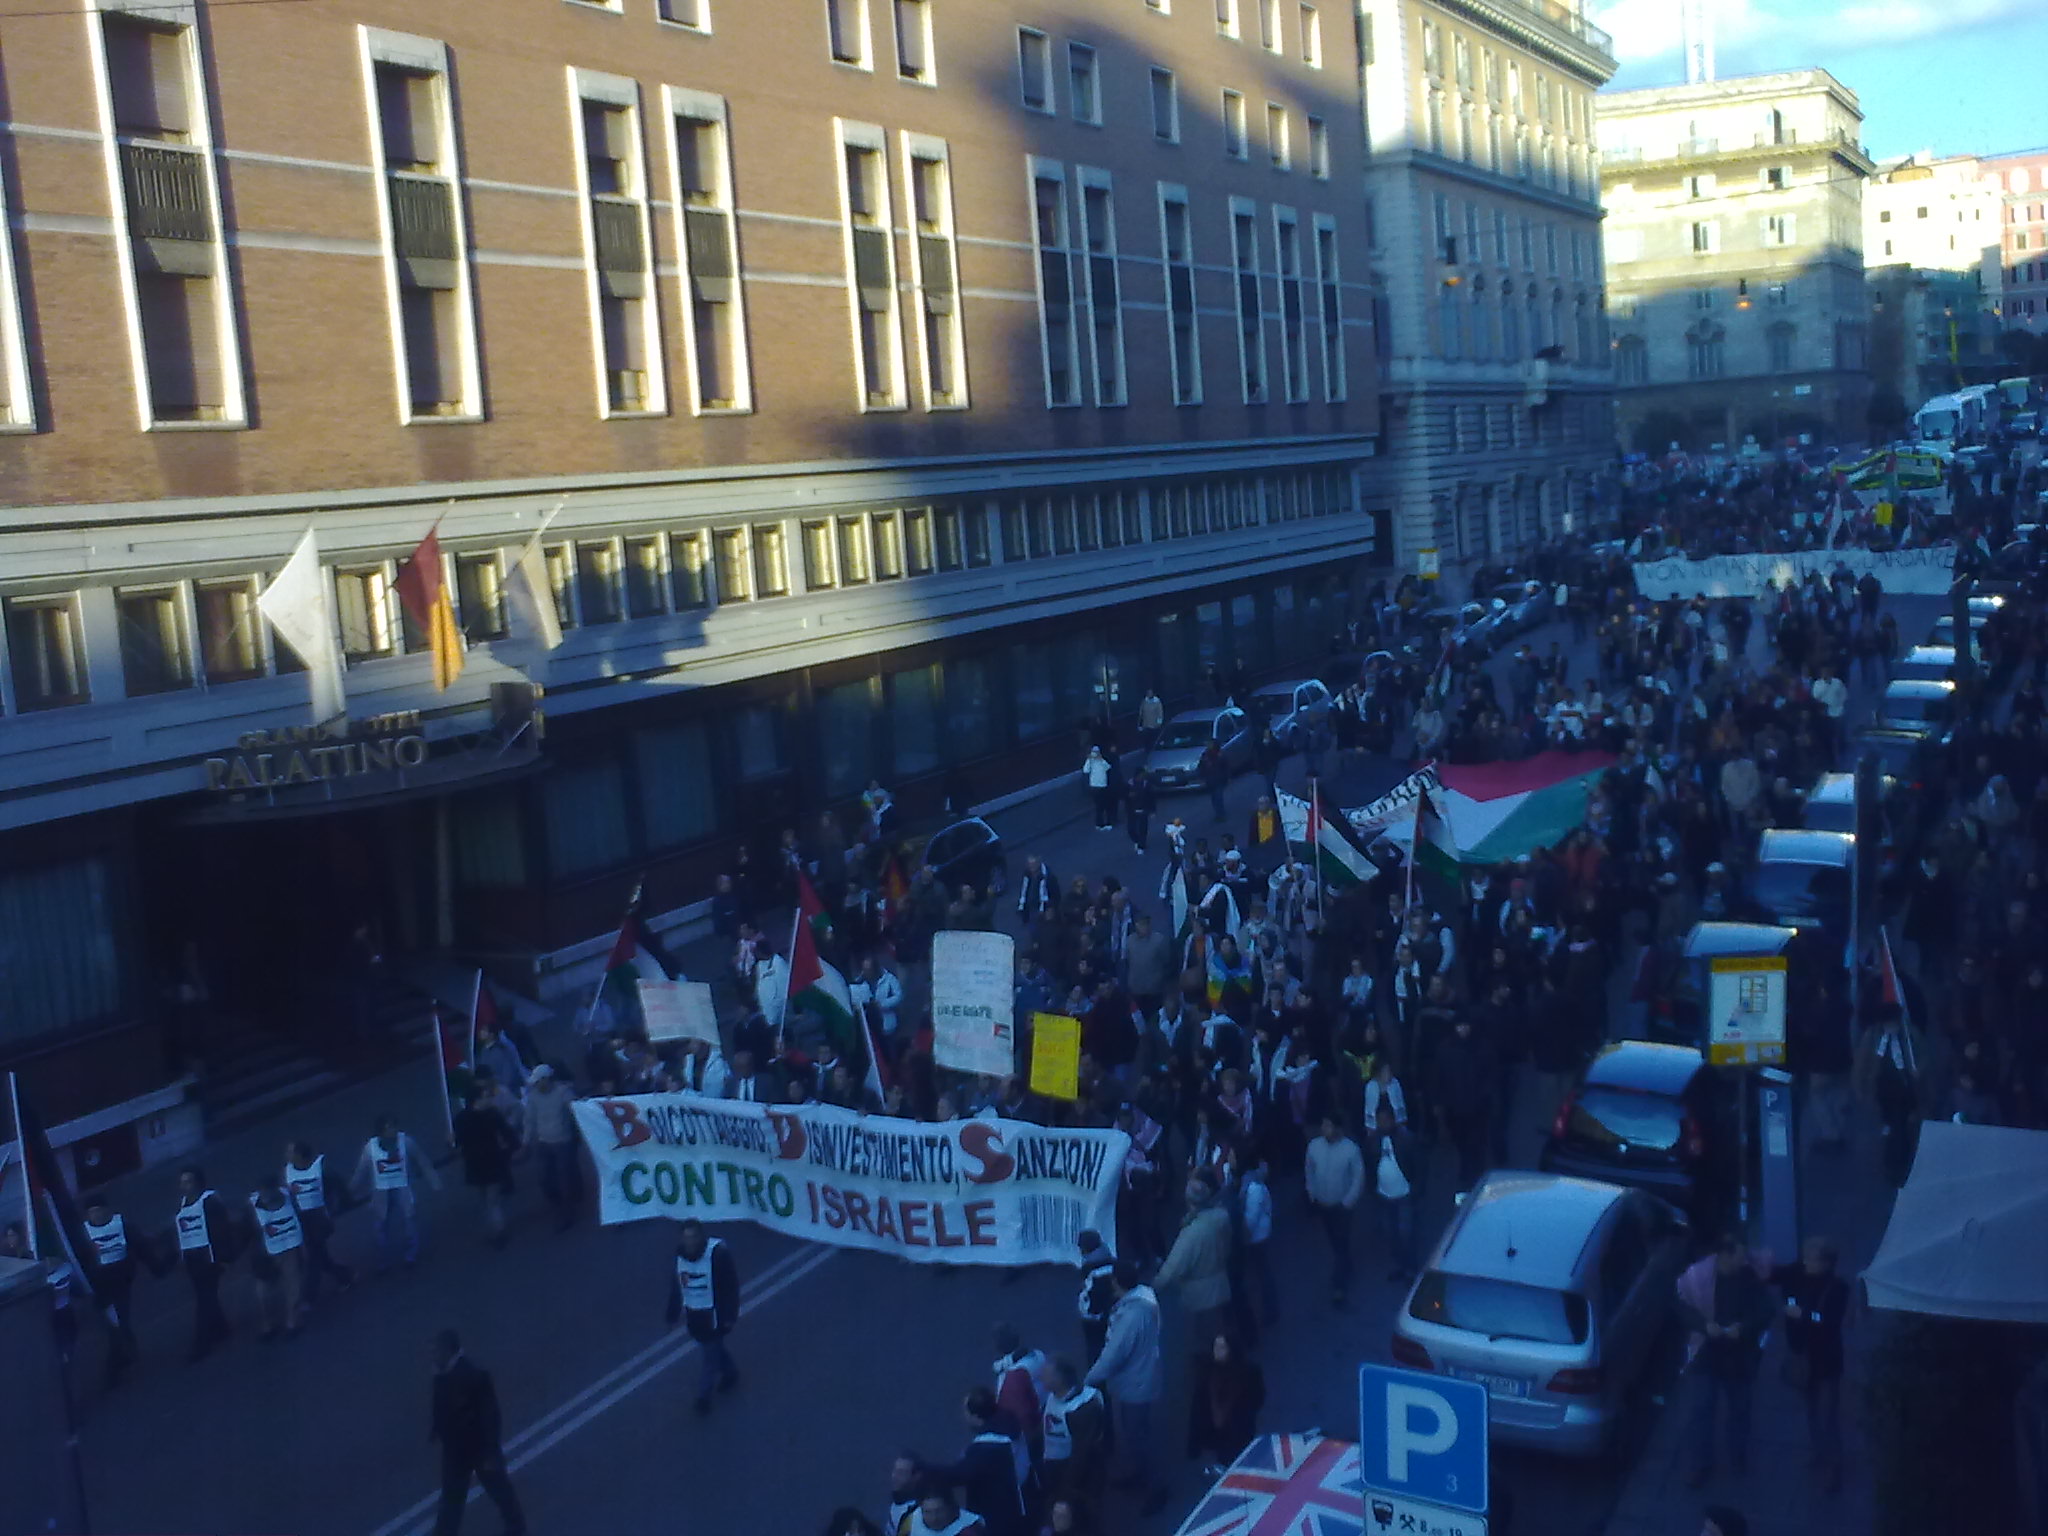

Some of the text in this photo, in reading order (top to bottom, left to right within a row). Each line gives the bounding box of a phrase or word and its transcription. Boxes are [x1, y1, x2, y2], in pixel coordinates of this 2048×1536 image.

[205, 735, 425, 791] PALATINO
[959, 1122, 1108, 1191] SANZIONI
[621, 1161, 998, 1247] CONTRO ISRAELE
[1386, 1382, 1459, 1483] P
[1446, 1473, 1458, 1493] 3
